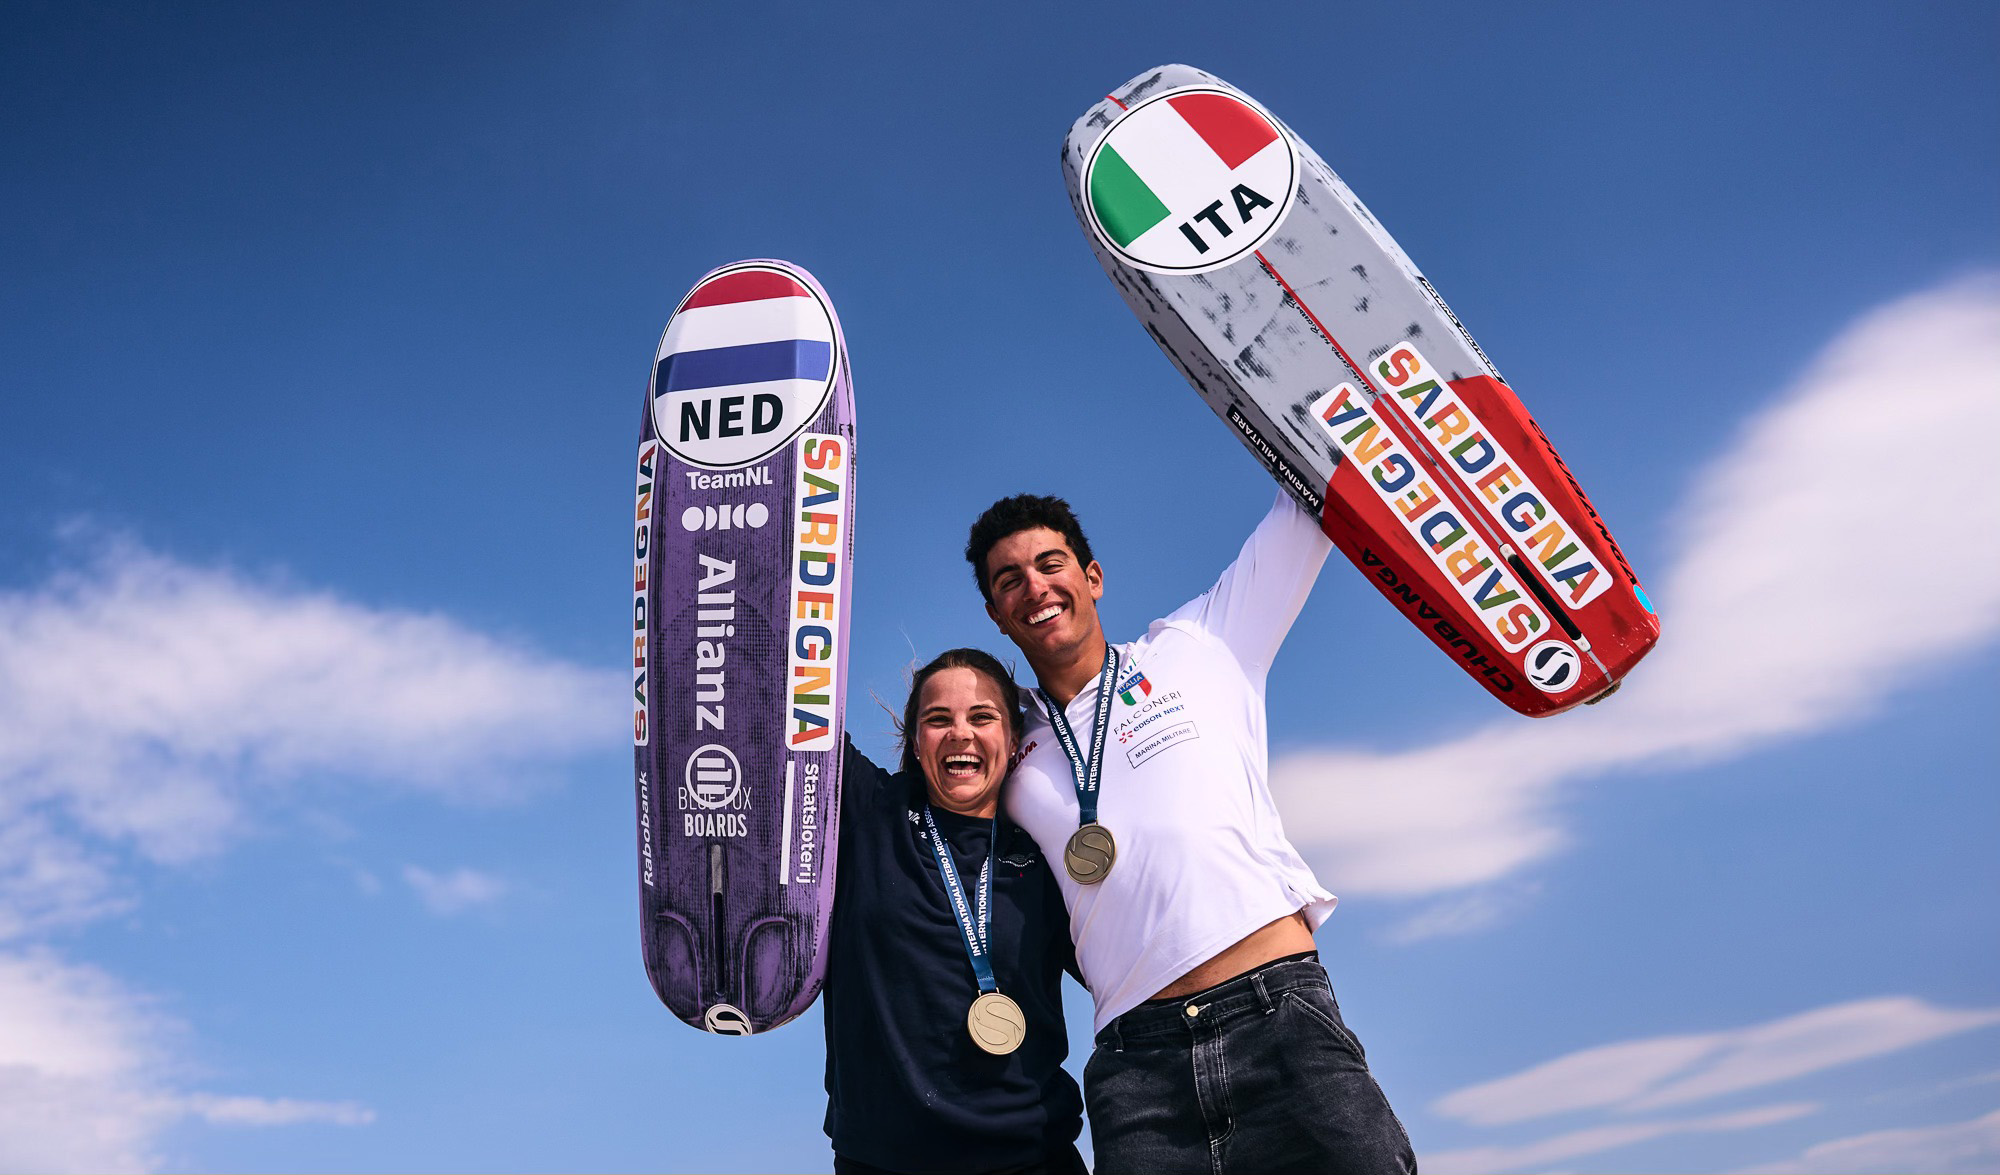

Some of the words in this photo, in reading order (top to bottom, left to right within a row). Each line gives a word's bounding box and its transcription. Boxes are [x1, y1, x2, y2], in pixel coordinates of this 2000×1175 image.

[1178, 183, 1274, 255] ITA
[1422, 280, 1458, 324] MARINA
[680, 393, 783, 442] NED
[1232, 411, 1278, 463] MILITARE
[686, 467, 773, 490] TeamNL
[1280, 461, 1319, 507] MARINA
[1379, 348, 1599, 604] SARDEGNA
[1530, 418, 1638, 586] CHUBANGA
[1322, 387, 1541, 645] SARDEGNA
[635, 444, 656, 741] SARDEGNA
[792, 438, 841, 745] SARDEGNA
[1361, 548, 1515, 693] CHUBANGA
[697, 554, 736, 730] Allianz
[1114, 690, 1182, 735] FALCONERI
[1119, 675, 1143, 692] ITALIA
[1088, 724, 1105, 791] INTERNATIONAL
[1135, 740, 1161, 759] MARINA
[1162, 727, 1192, 743] MILITARE
[639, 771, 654, 886] Rabobank
[684, 813, 748, 837] BOARDS
[796, 763, 819, 884] Staatsloterij
[952, 885, 981, 957] INTERNATIONAL
